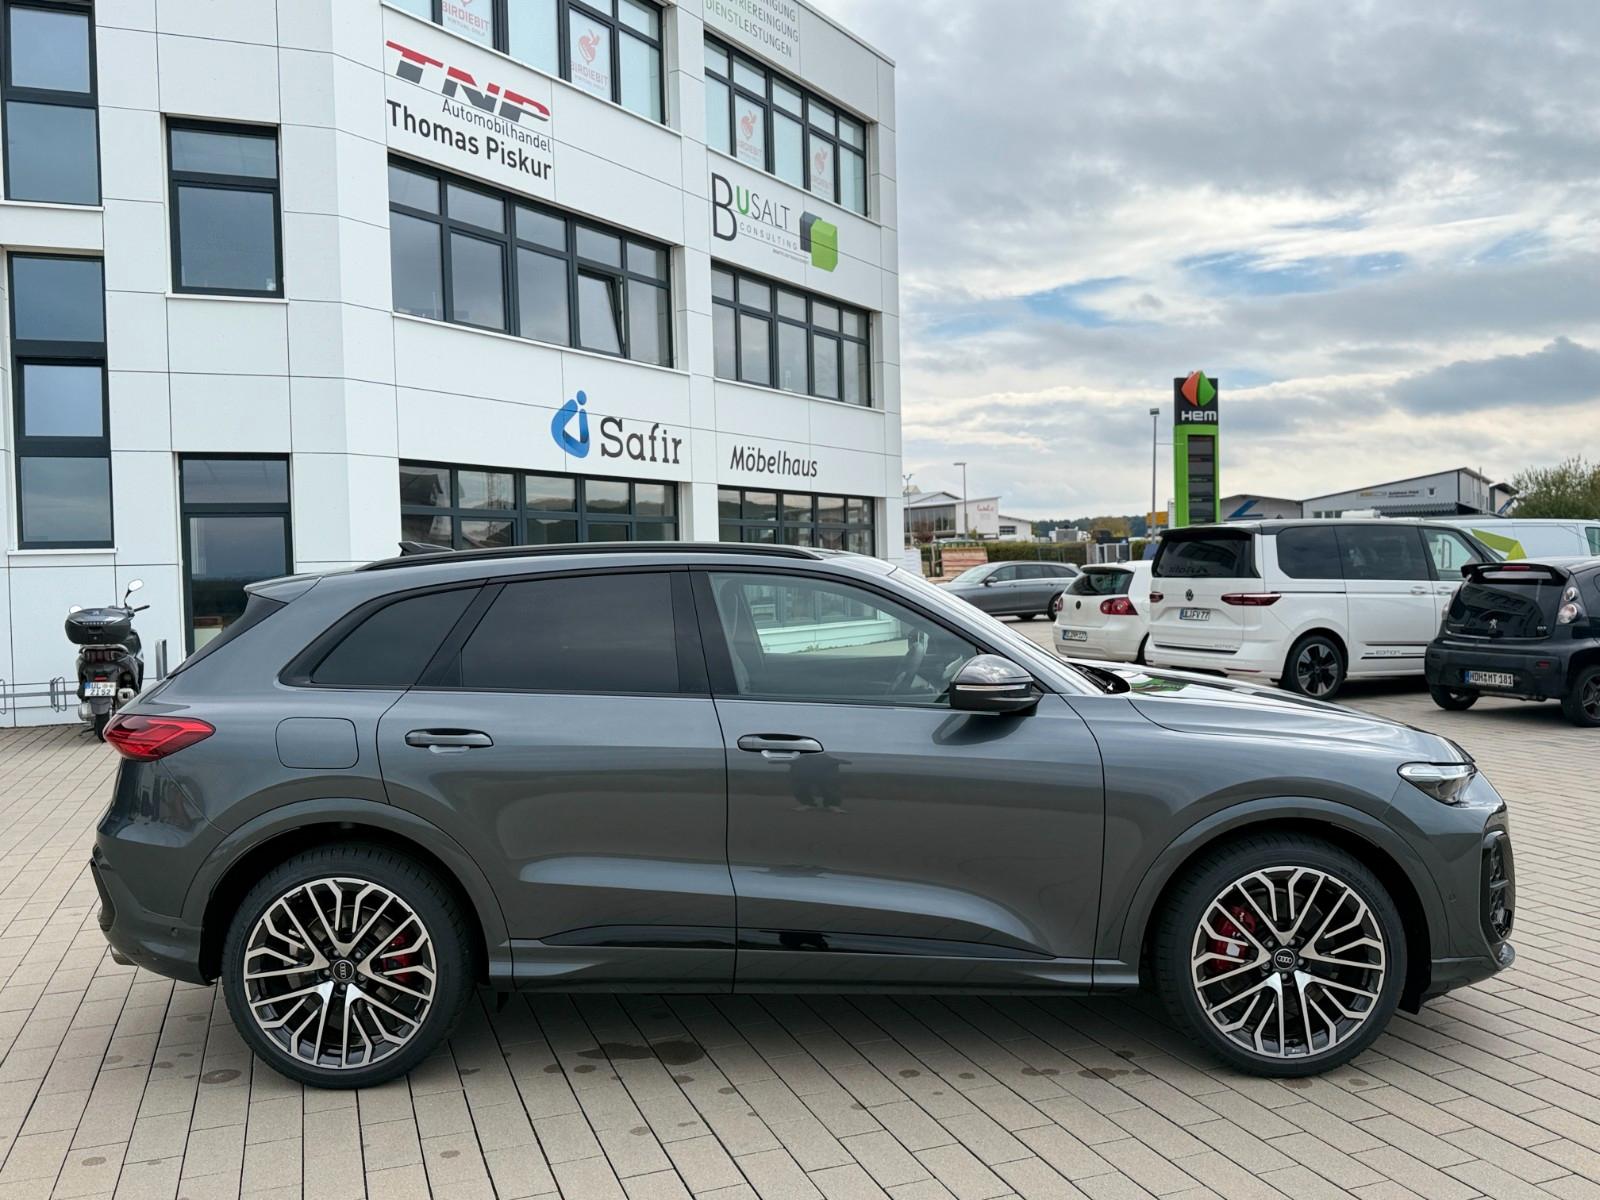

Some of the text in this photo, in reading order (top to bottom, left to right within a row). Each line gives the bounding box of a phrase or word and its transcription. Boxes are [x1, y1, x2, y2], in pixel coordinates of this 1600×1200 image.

[442, 1, 490, 31] BIRDIEBIT
[386, 40, 550, 122] TNP
[387, 99, 552, 180] Thomas Piskur
[442, 99, 551, 153] Automobilhandel
[740, 222, 798, 250] CONSULTING
[600, 416, 682, 464] Safir
[730, 445, 818, 478] Möbelhaus
